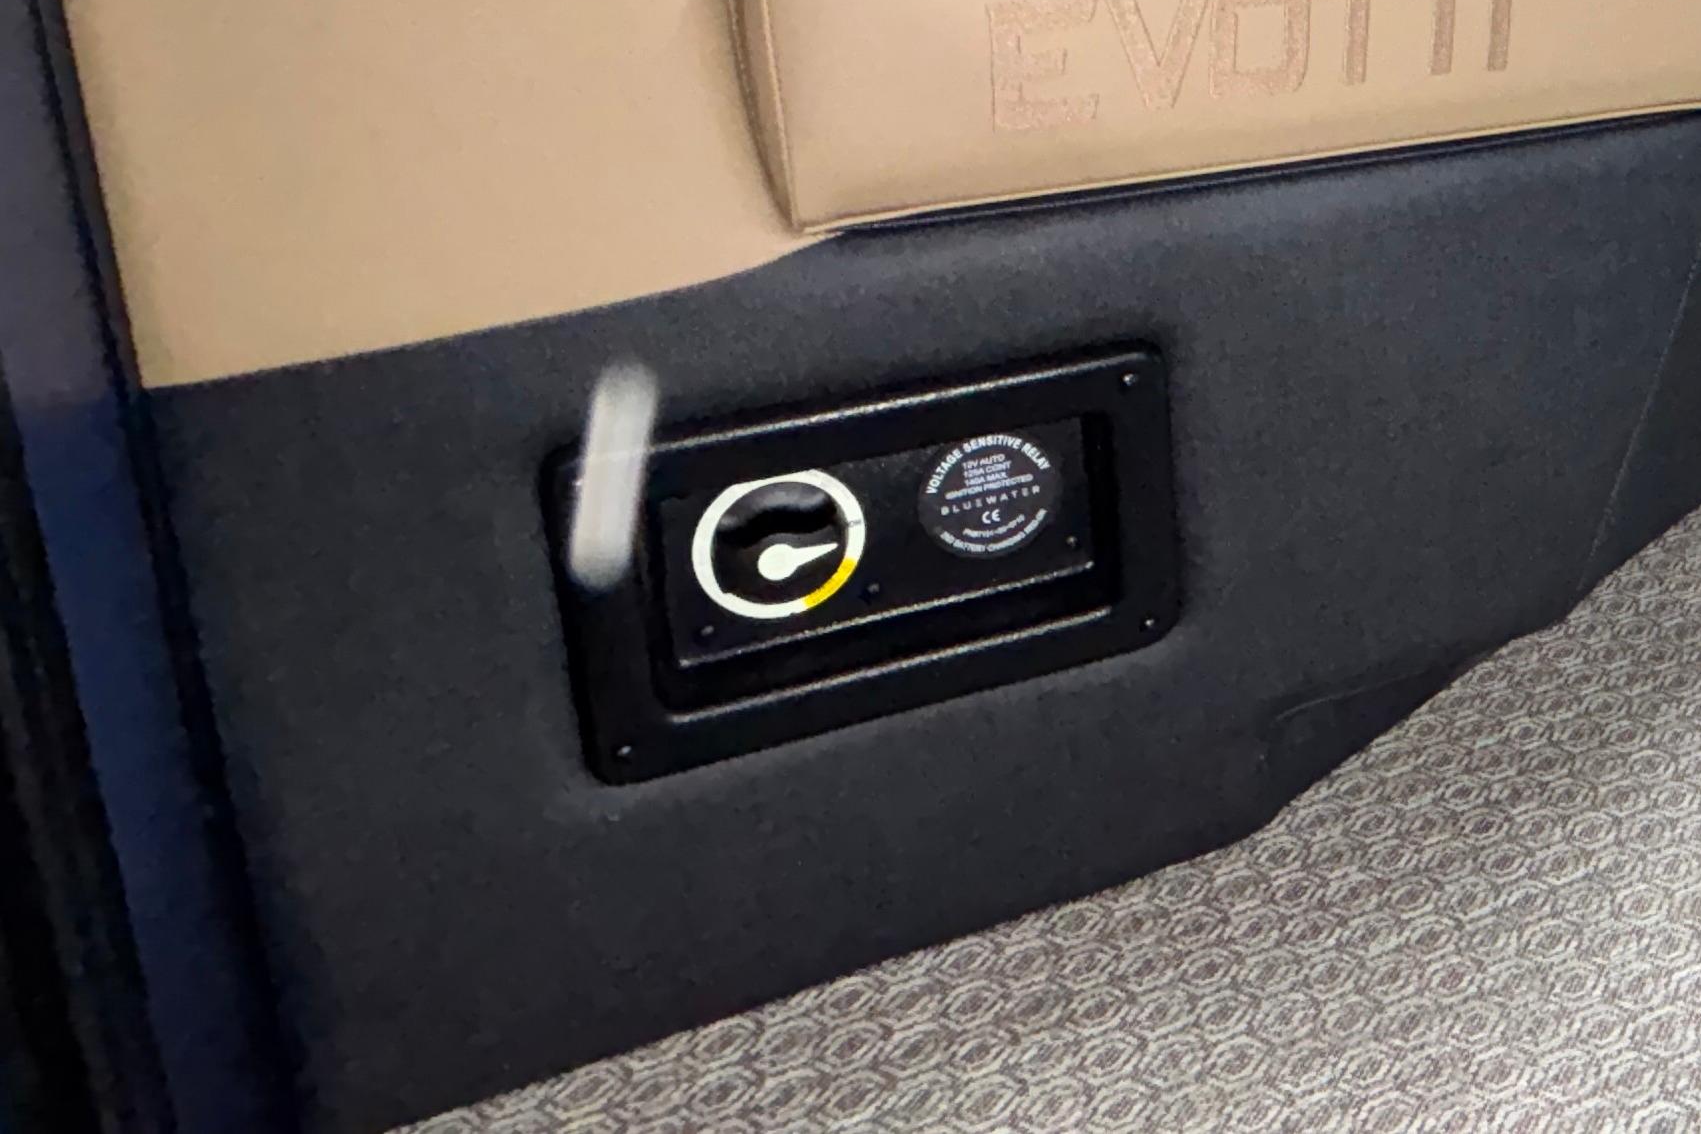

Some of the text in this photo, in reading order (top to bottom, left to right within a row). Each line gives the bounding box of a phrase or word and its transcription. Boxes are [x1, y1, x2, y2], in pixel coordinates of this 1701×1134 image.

[926, 434, 1050, 494] VOLTAGE SENSITIVE RELAY
[980, 453, 1005, 465] AUTO
